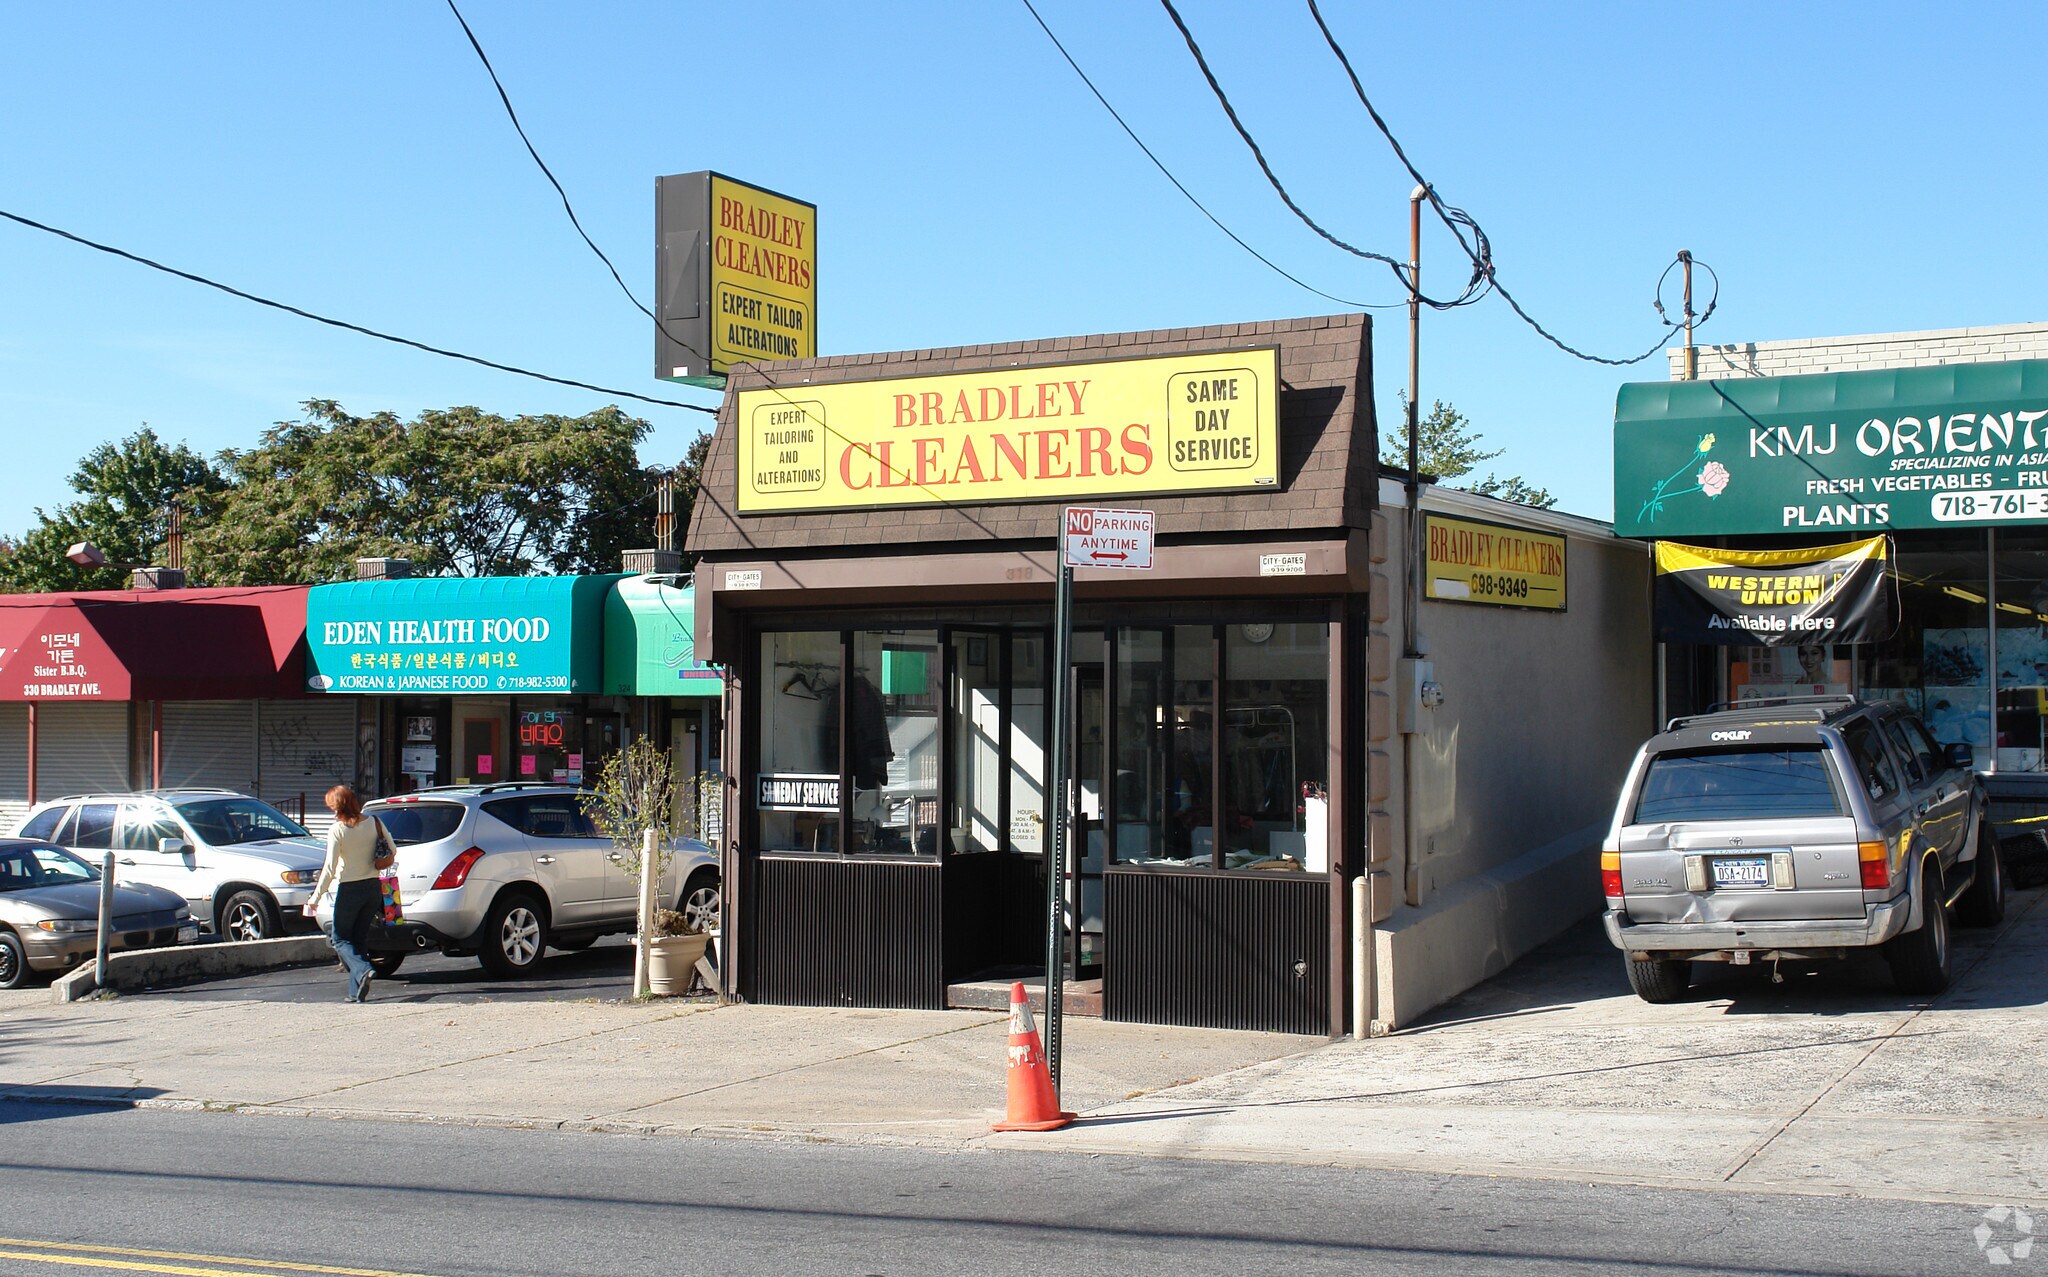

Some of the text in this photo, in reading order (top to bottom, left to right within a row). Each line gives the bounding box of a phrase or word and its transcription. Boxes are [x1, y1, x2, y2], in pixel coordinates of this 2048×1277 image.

[720, 196, 806, 250] BRADLEY
[715, 235, 811, 290] CLEANERS
[722, 291, 803, 331] EXPERT TAILOR
[728, 323, 798, 358] ALTERATIONS
[1186, 378, 1239, 403] SAME
[893, 380, 1092, 428] BRADLEY
[770, 410, 807, 426] EXPERT
[1195, 408, 1230, 432] DAY
[764, 429, 814, 445] TAILORING
[1749, 409, 2048, 459] KMJ ORIENT
[779, 450, 799, 464] AND
[839, 422, 1154, 491] CLEANERS
[1175, 437, 1252, 463] SERVICE
[1889, 455, 1991, 471] SPECIALIZING
[1994, 454, 2014, 467] IN
[757, 468, 821, 485] ALTERATIONS
[1805, 477, 1864, 495] FRESH
[1871, 472, 1993, 492] VEGETABLES
[1069, 512, 1150, 532] NO PARKING
[1783, 503, 1890, 527] PLANTS
[1081, 537, 1139, 550] ANYTIME
[1430, 525, 1562, 577] BRADLEY CLEANERS
[1471, 573, 1528, 598] 698-9349
[1707, 574, 1821, 591] WESTERN
[1740, 590, 1819, 605] UNION
[323, 617, 550, 645] EDEN HEALTH FOOD
[1708, 613, 1836, 631] Available Here
[40, 632, 80, 648] 이모네
[47, 649, 75, 664] 가든
[34, 664, 87, 677] Sister B.B.Q.
[23, 683, 101, 696] 330 BRADLEY AVE.
[339, 675, 568, 691] KOREAN & JAPANESE FOOD 718-982-5300
[1711, 731, 1752, 742] OAKLEY
[803, 782, 839, 805] SERVICE
